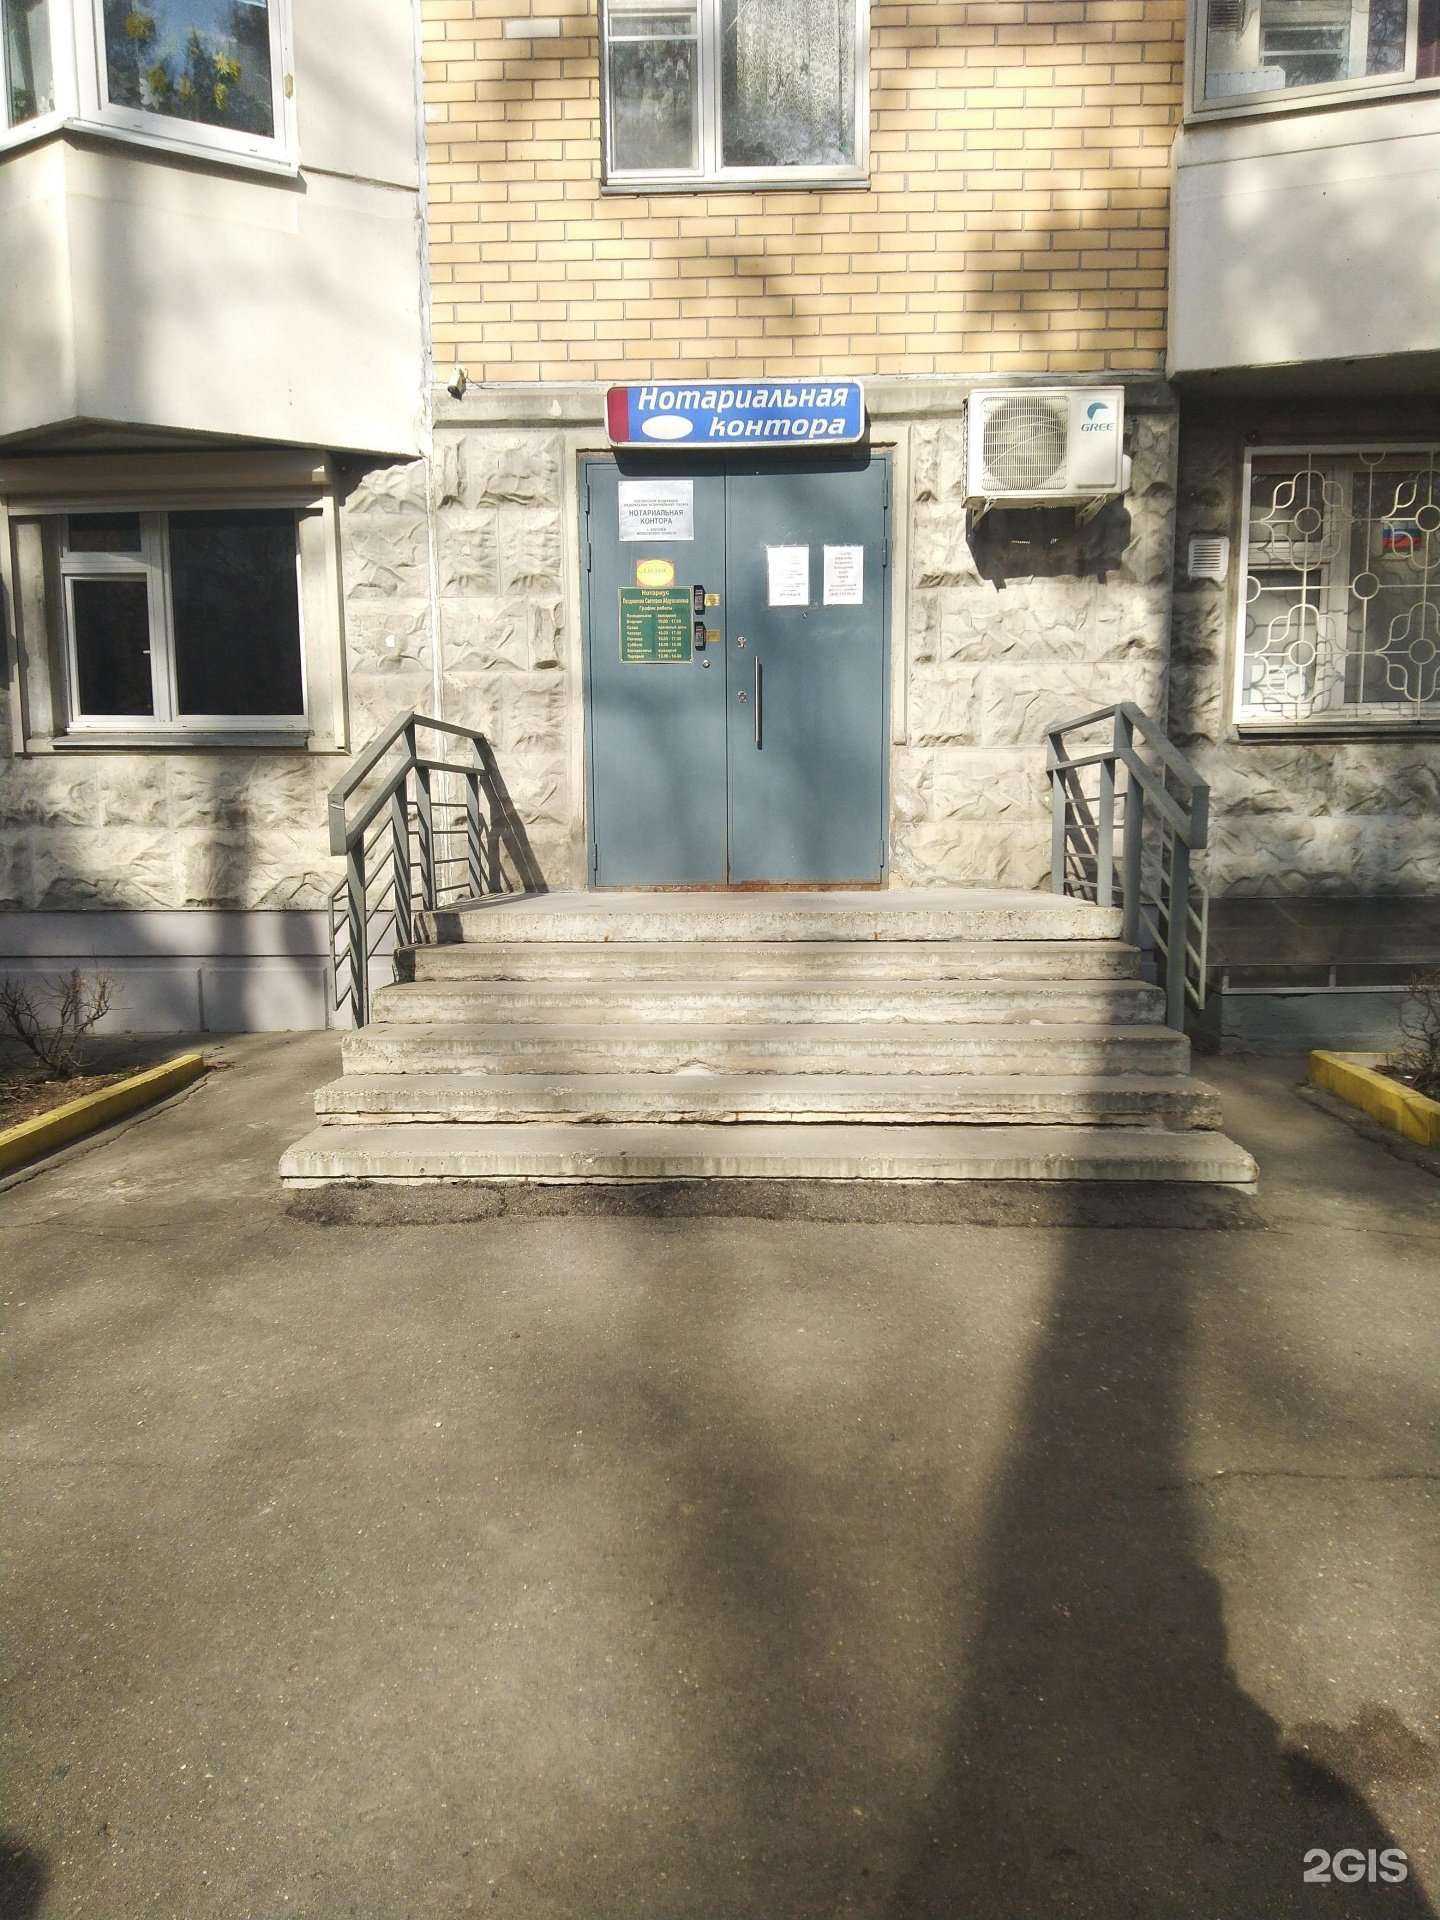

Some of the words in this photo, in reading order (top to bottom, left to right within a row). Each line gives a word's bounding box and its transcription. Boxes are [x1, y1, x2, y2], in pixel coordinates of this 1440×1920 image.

[638, 386, 849, 413] Нотариальная
[709, 416, 847, 439] контора
[1080, 423, 1112, 432] GREE
[628, 509, 684, 517] НОТАРИАЛЬНАЯ
[640, 517, 673, 525] КОНТОРА
